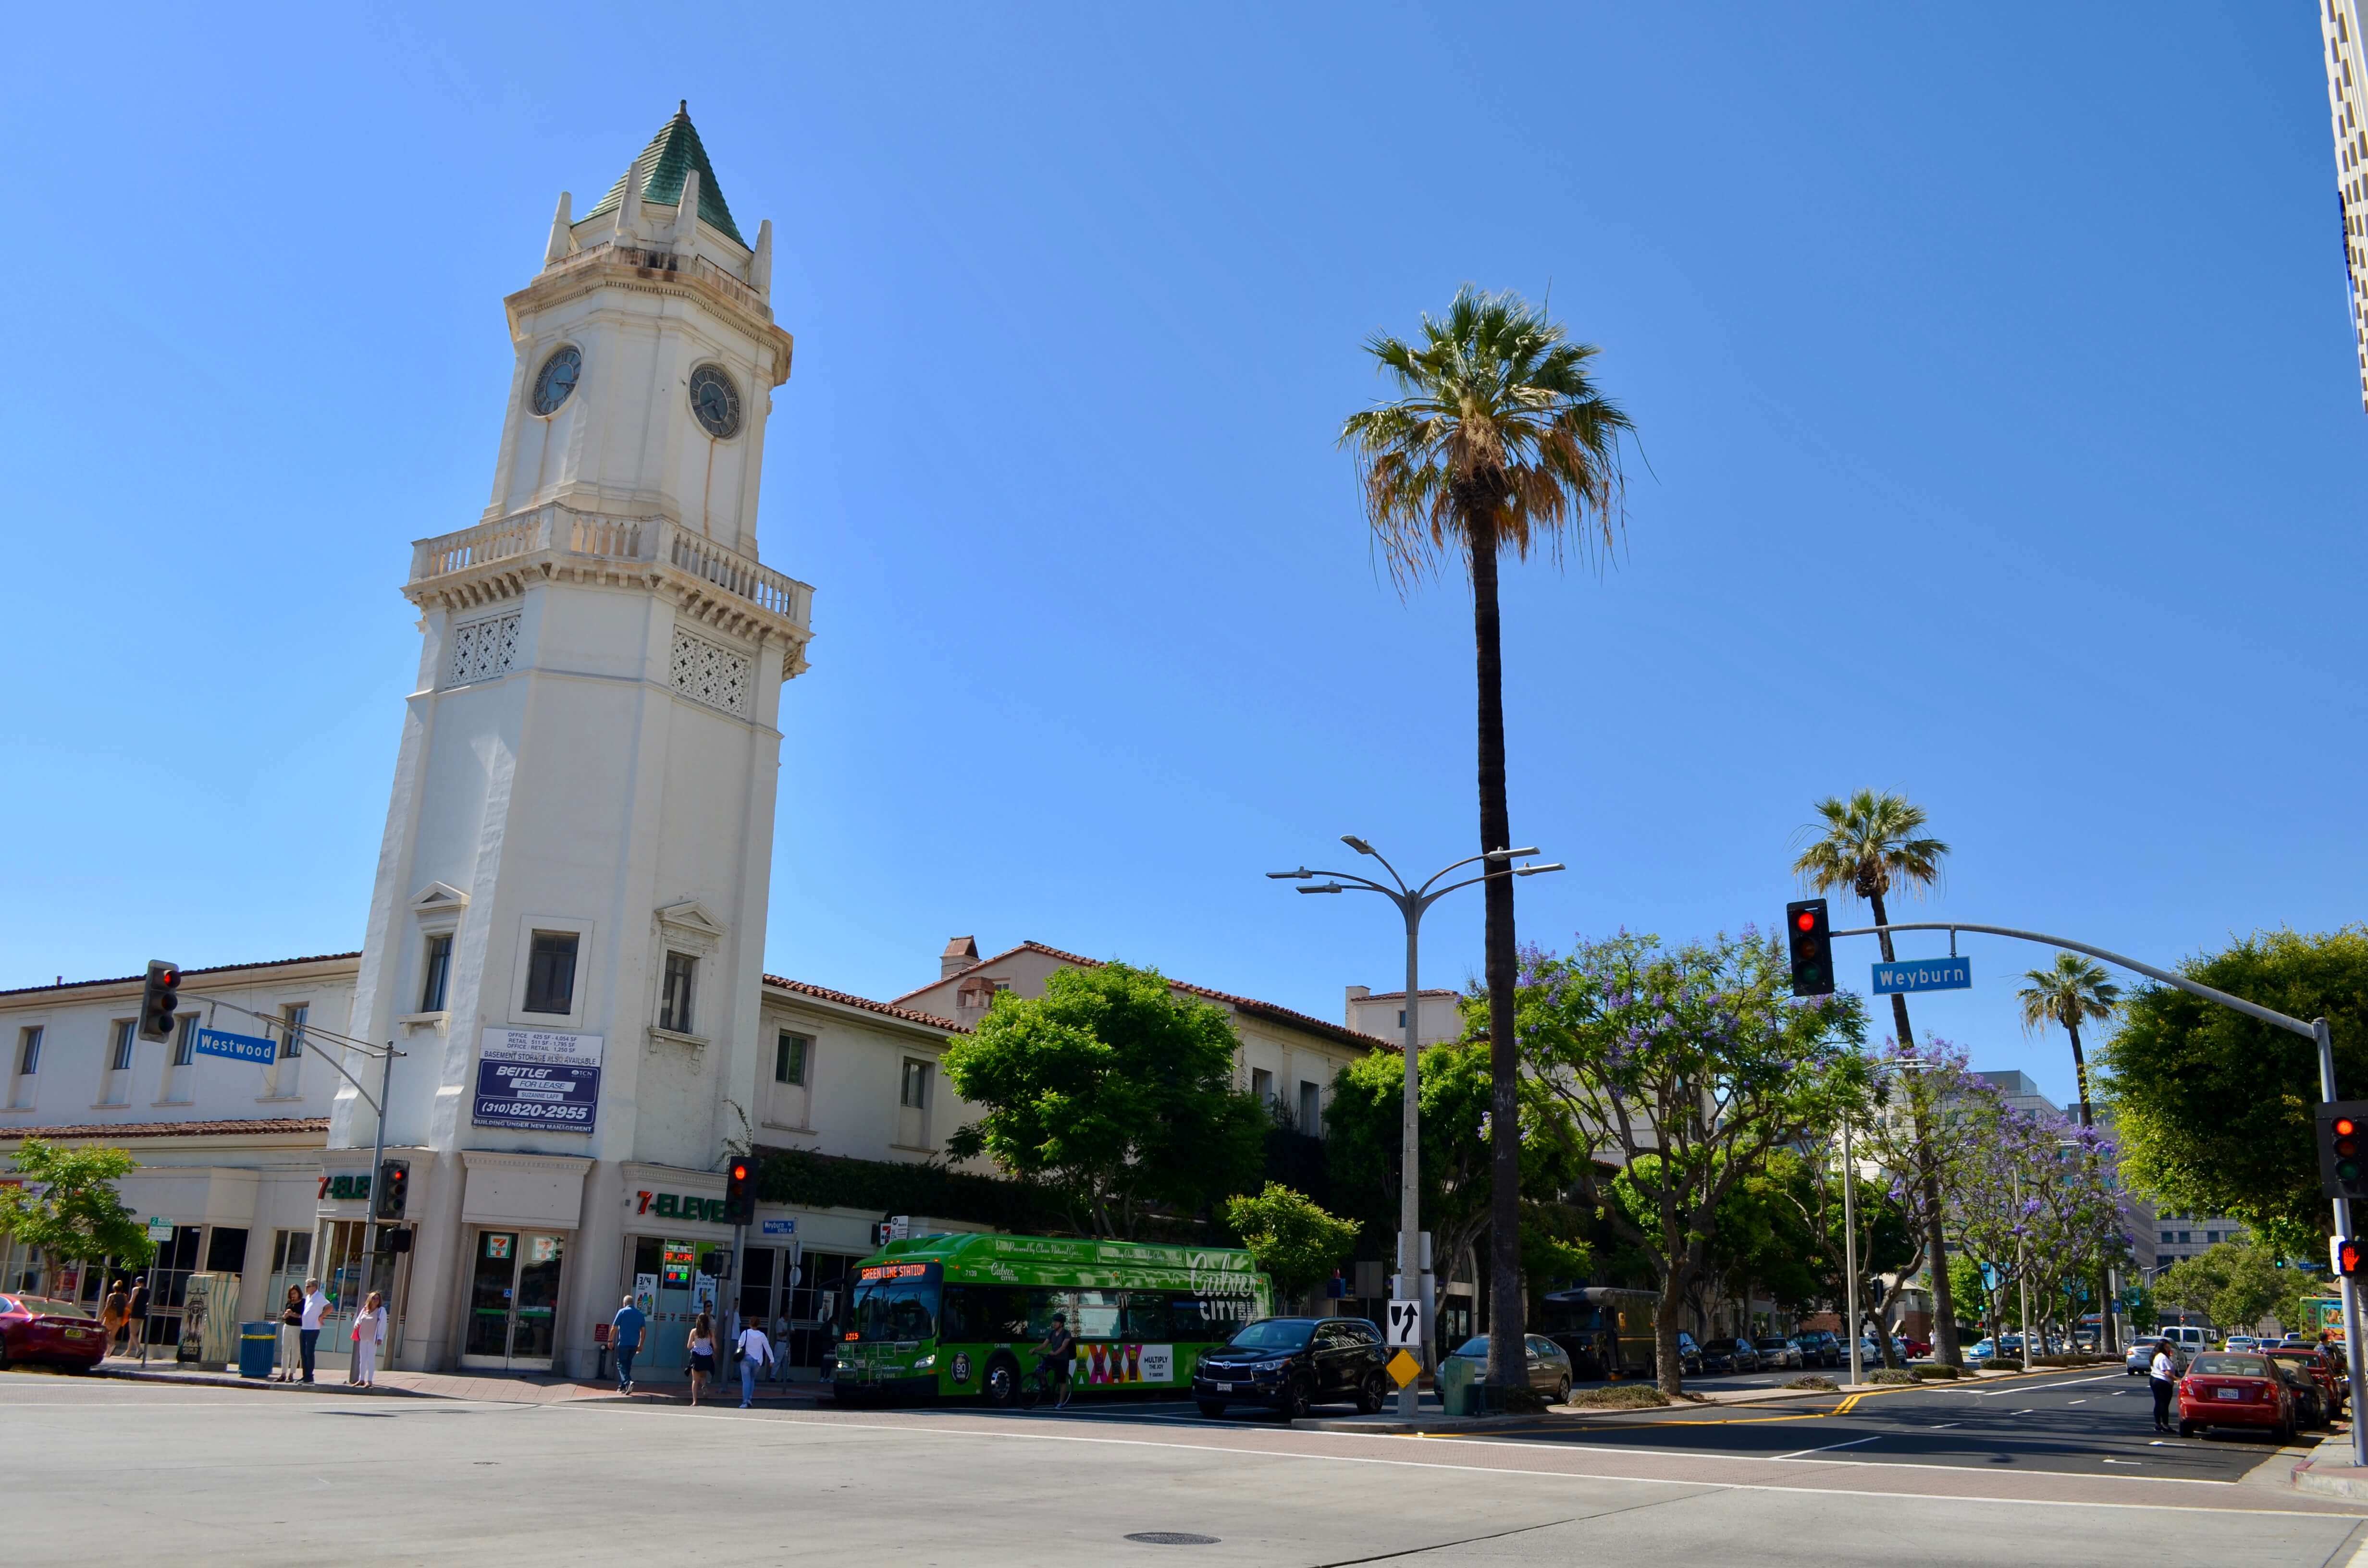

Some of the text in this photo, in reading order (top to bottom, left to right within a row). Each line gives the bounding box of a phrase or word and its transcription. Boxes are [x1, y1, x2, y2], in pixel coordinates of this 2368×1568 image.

[1879, 968, 1964, 988] Weyburn
[201, 1034, 271, 1058] Westwood
[484, 1051, 596, 1065] BASEMENT STORAGE ALSO AVAILABLE
[473, 1118, 505, 1127] BUILDING
[548, 1123, 592, 1132] MANAGEMENT
[765, 1222, 784, 1230] Weyburn
[1009, 1241, 1029, 1253] Powered
[1036, 1243, 1050, 1253] Clean
[1051, 1244, 1069, 1254] Natural
[862, 1264, 925, 1280] GREEN LINE STATION
[991, 1262, 1015, 1276] Culver
[1191, 1253, 1257, 1297] Culver
[956, 1363, 966, 1373] 90
